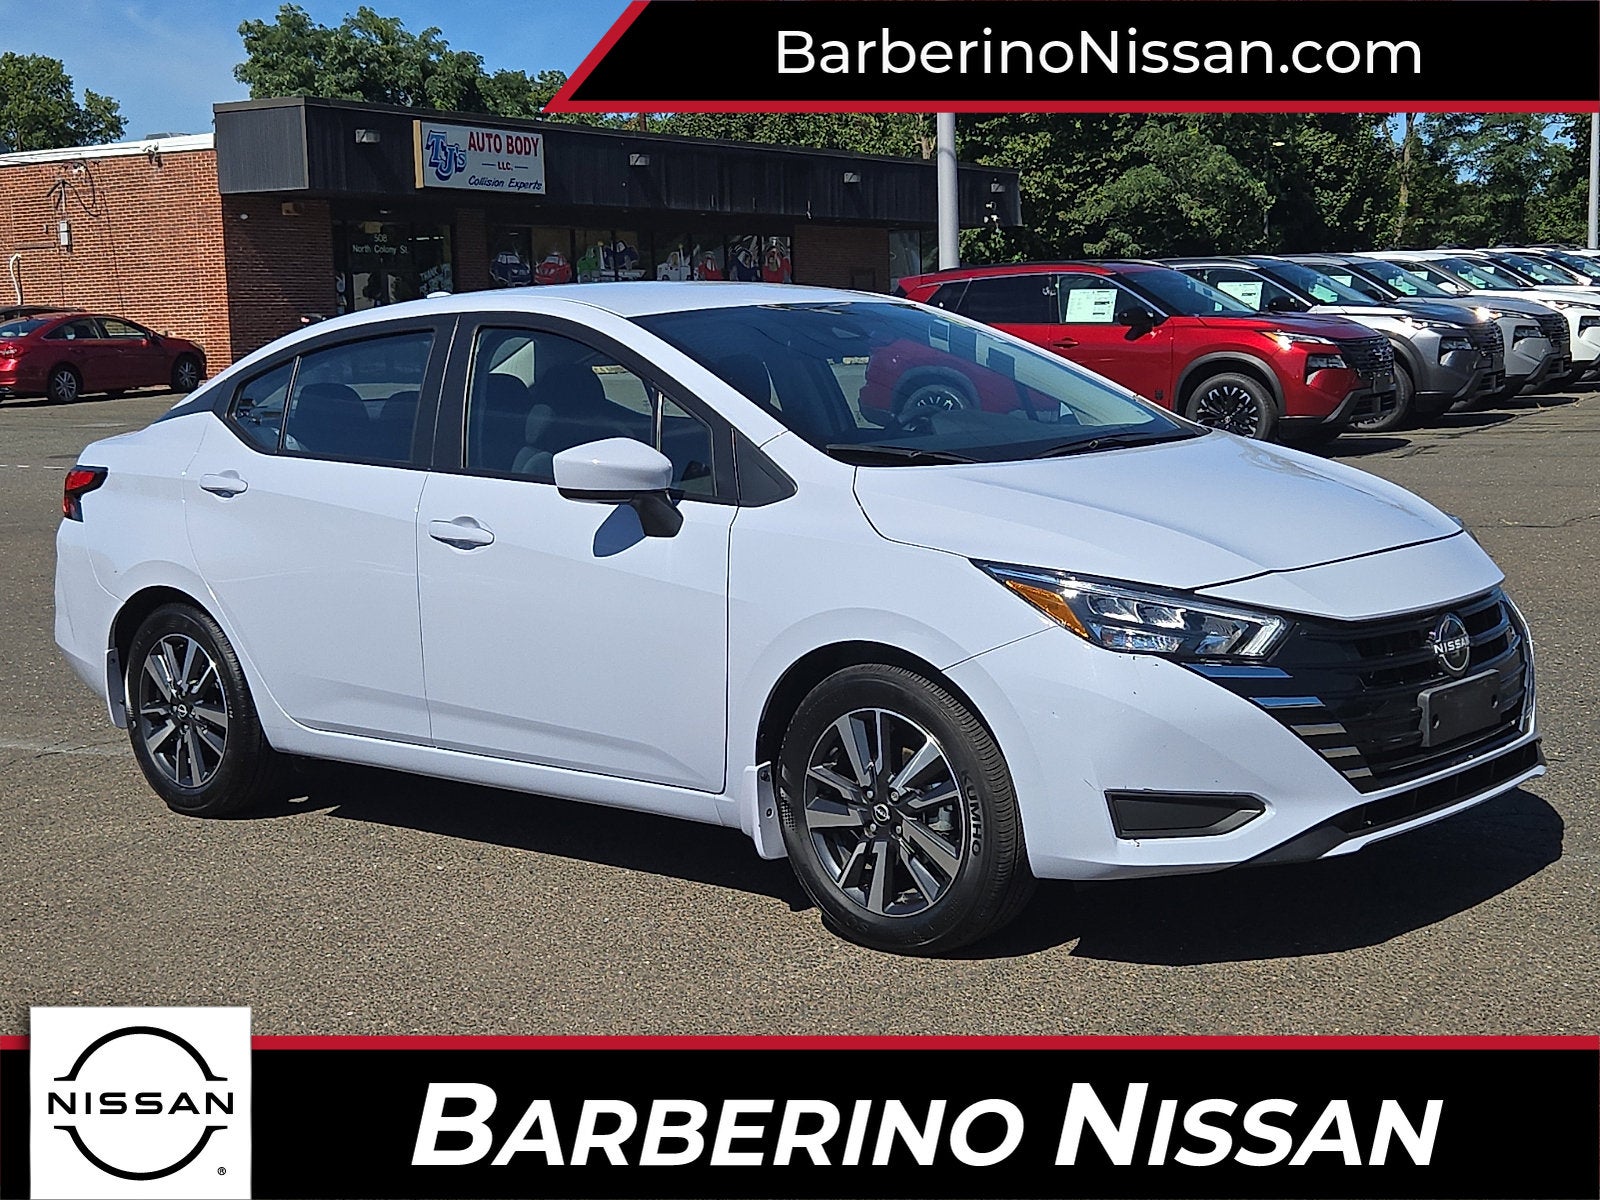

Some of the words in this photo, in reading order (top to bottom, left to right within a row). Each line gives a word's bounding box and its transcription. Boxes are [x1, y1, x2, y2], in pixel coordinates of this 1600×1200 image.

[468, 131, 502, 153] AUTO
[506, 134, 540, 157] BODY
[497, 161, 513, 171] LLC.
[468, 175, 504, 188] Collision
[508, 178, 543, 190] Experts
[352, 244, 371, 253] North
[374, 244, 396, 255] Colony
[962, 770, 982, 856] KUMHO
